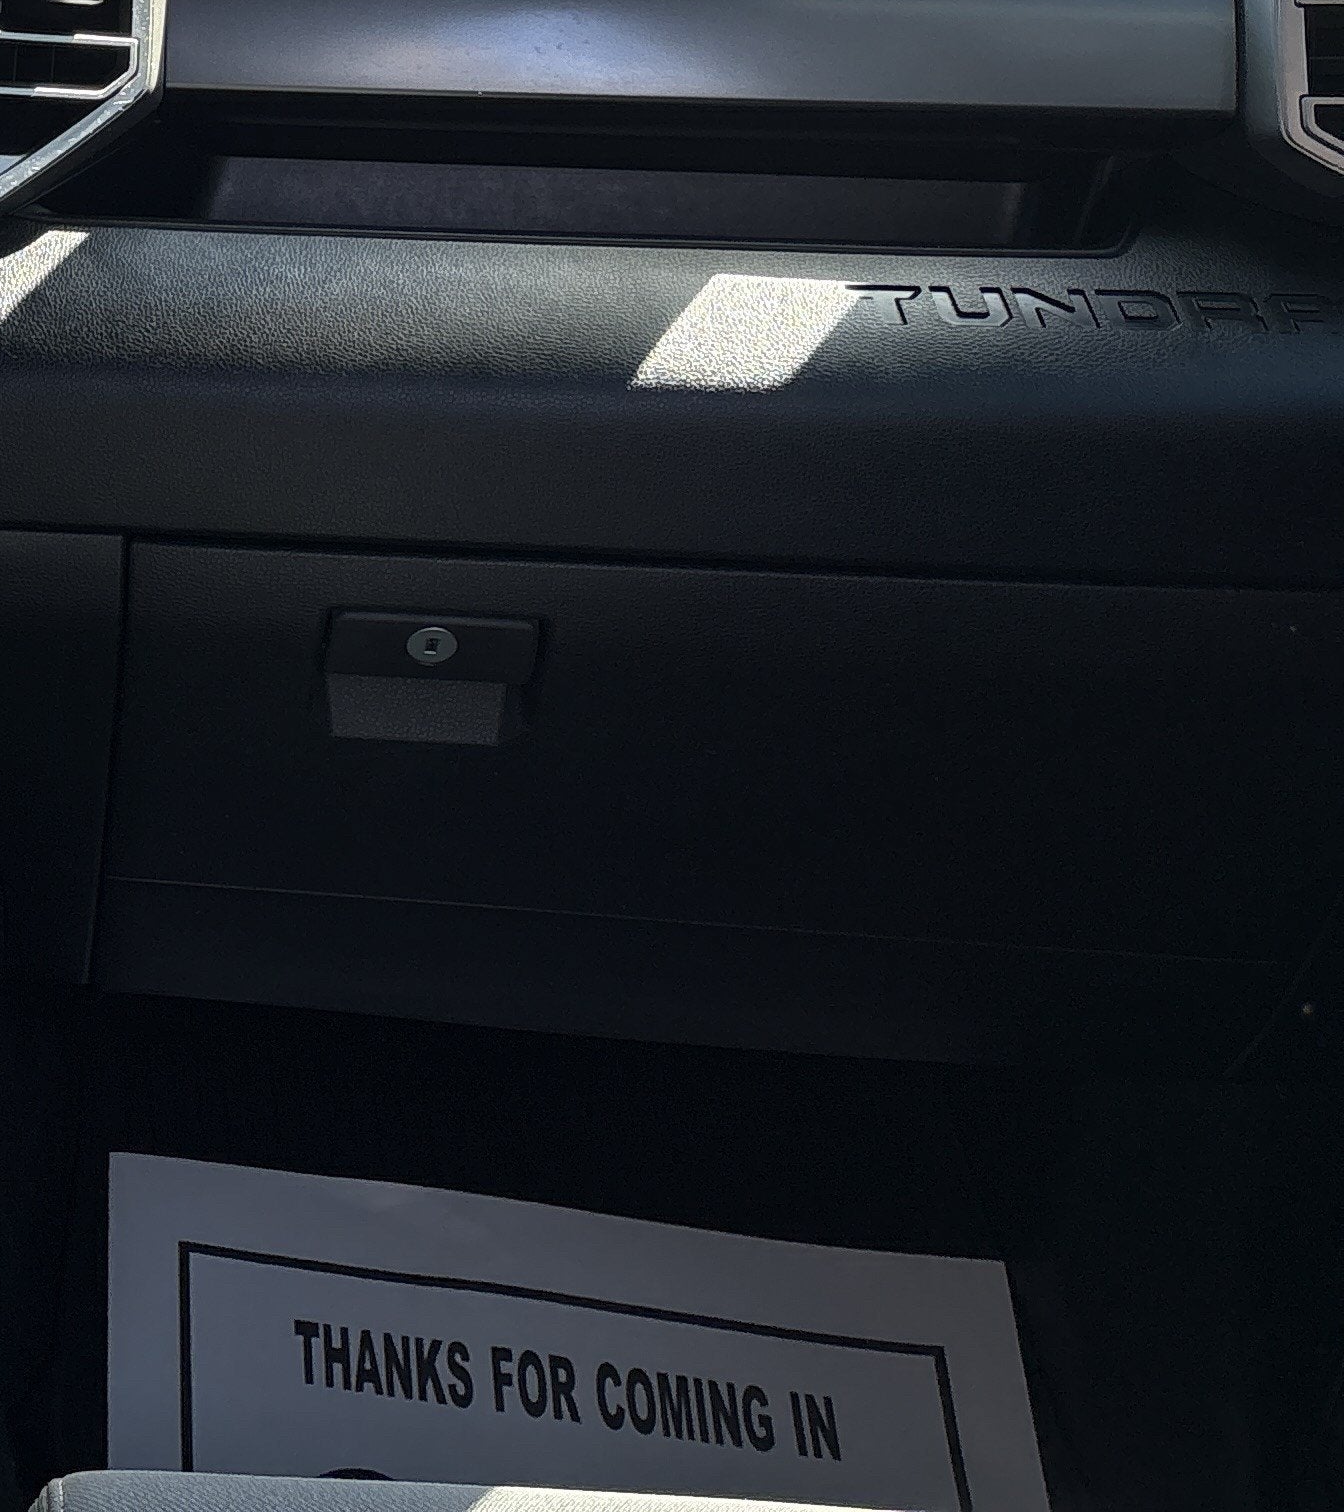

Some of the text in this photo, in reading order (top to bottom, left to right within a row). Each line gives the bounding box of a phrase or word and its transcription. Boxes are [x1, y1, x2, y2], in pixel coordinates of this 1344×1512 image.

[845, 284, 1344, 335] TUNDRA
[292, 1318, 843, 1464] THANKS FOR COMING IN
